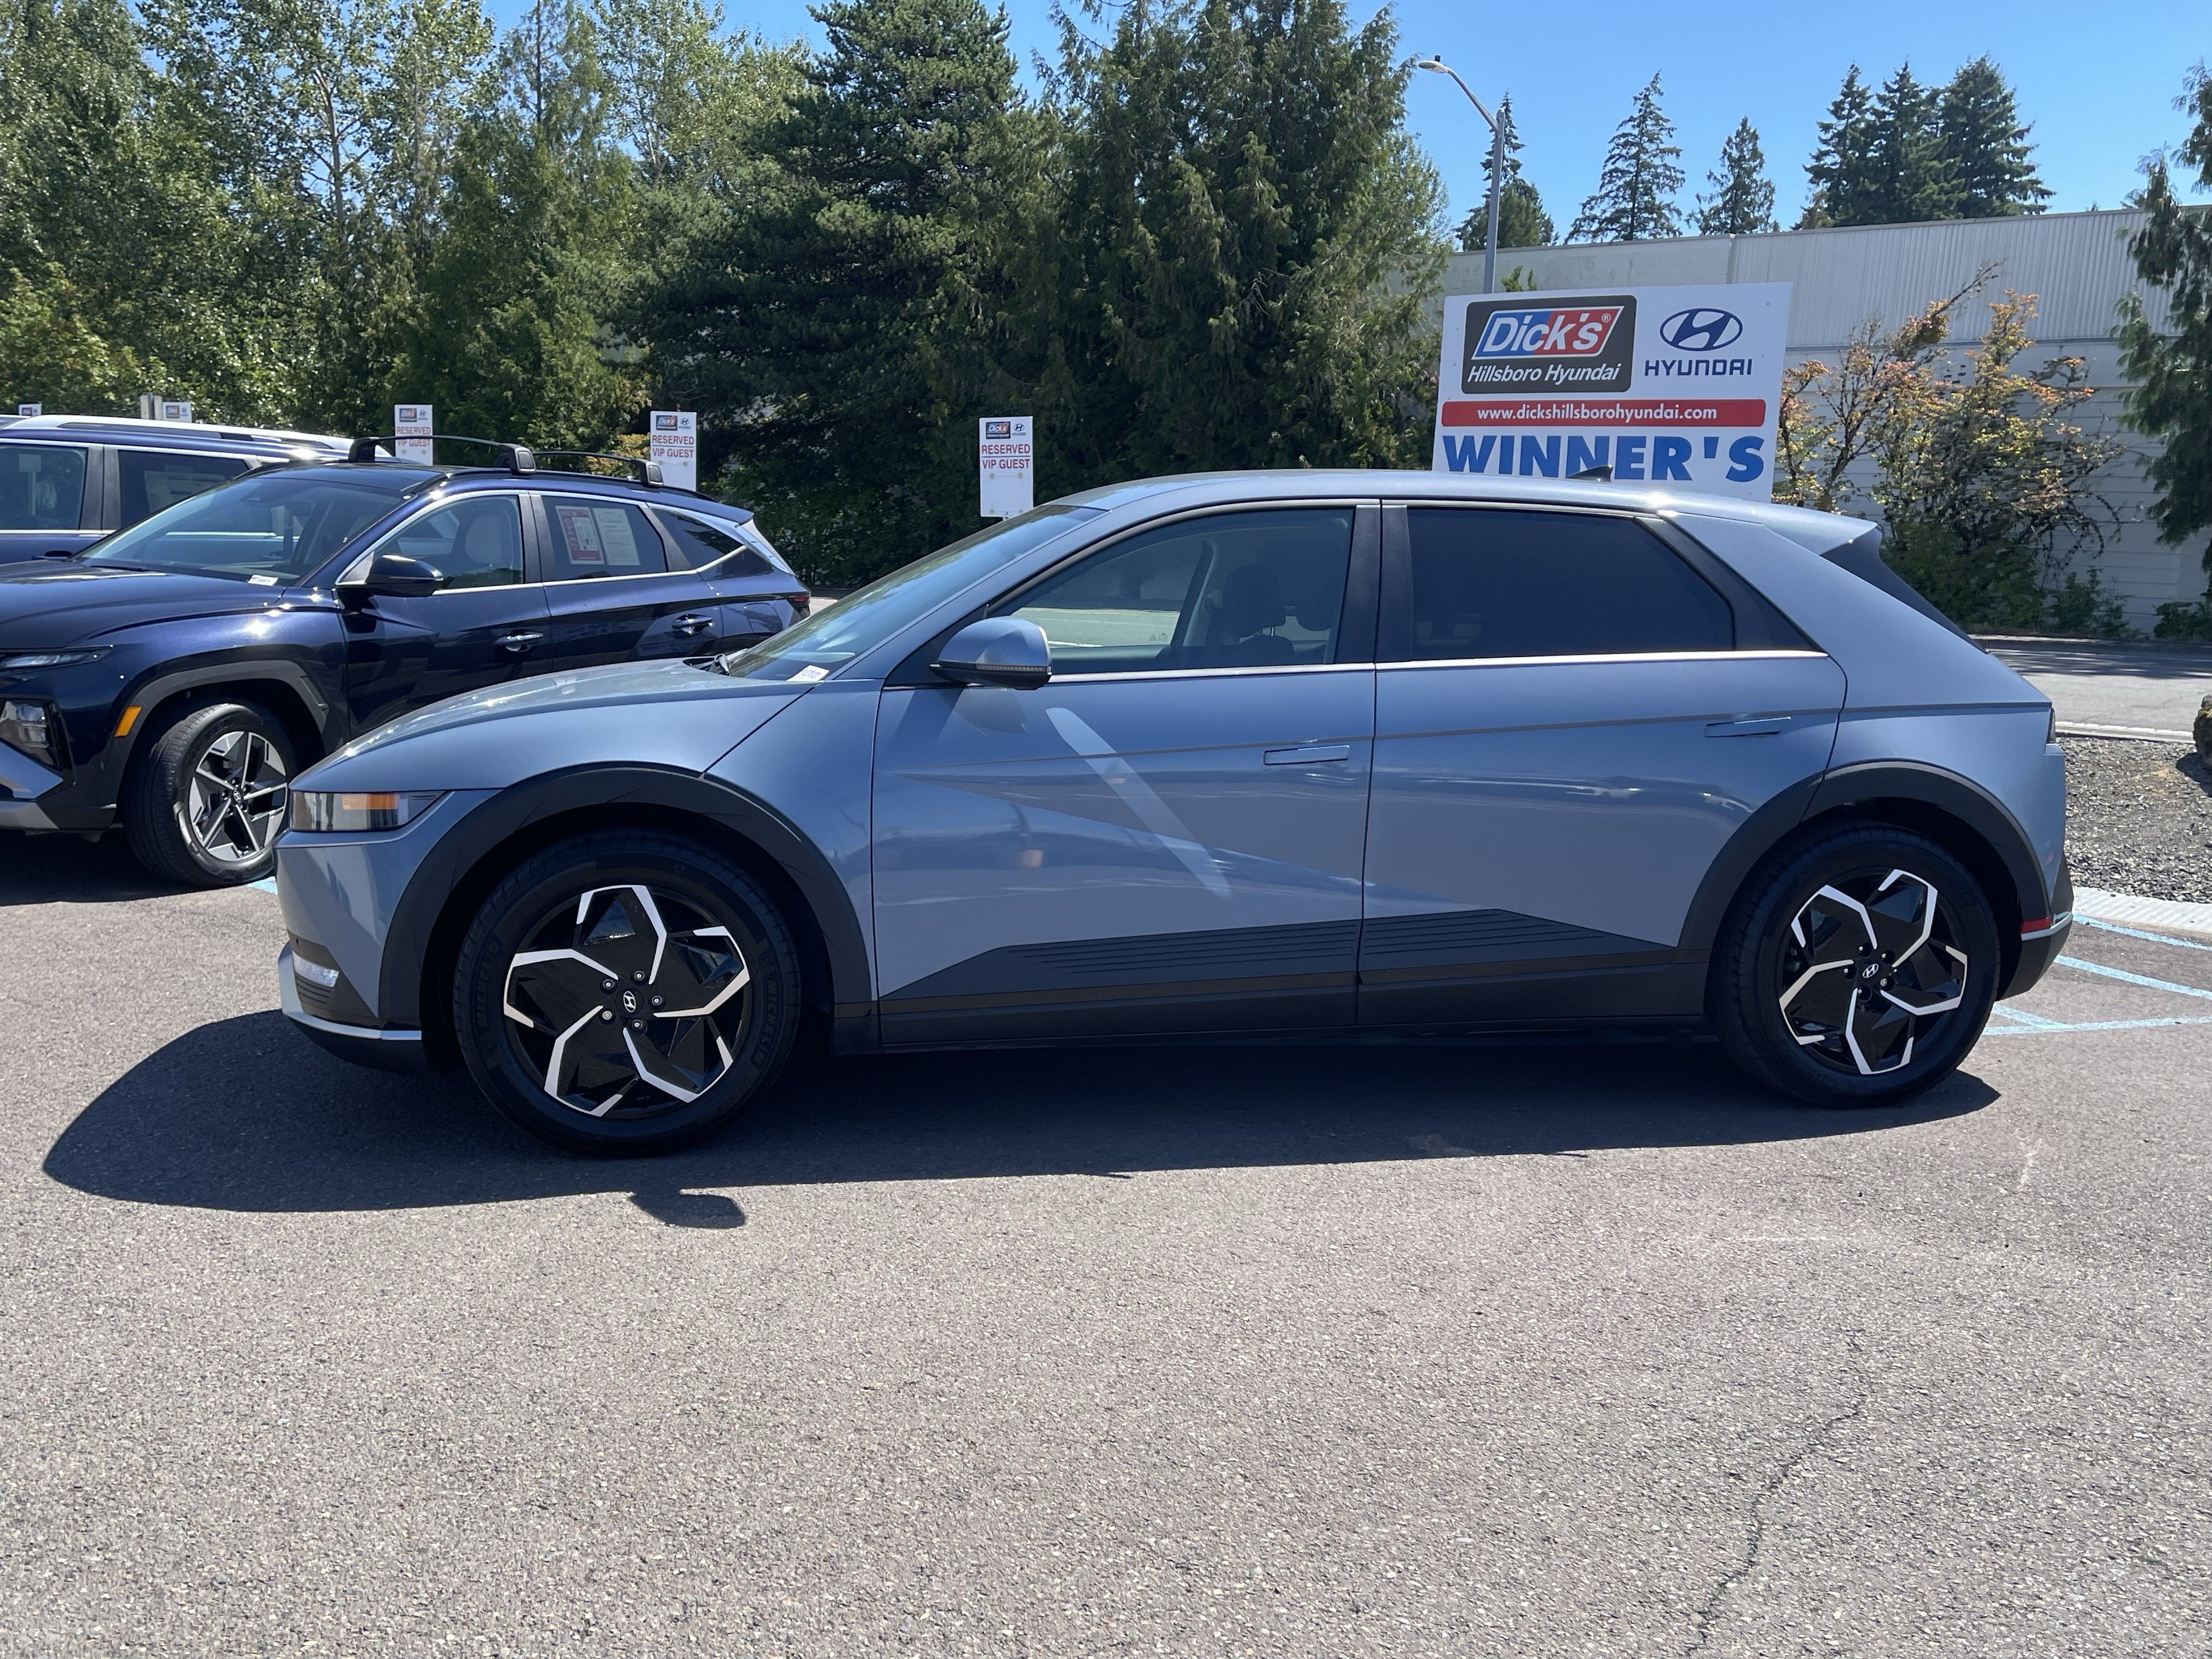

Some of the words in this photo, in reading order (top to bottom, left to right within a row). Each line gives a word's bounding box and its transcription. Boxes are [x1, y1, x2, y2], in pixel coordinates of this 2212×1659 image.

[1483, 313, 1602, 352] Dick's
[1467, 365, 1542, 382] Hillsboro
[1544, 363, 1622, 385] Hyundai
[1645, 359, 1752, 376] HYUNDAI
[1477, 403, 1717, 423] www.dickshillsborohyundai.com
[397, 426, 431, 435] RESERVED
[652, 435, 694, 444] RESERVED
[653, 448, 665, 456] VIP
[667, 449, 694, 458] GUEST
[981, 444, 1030, 454] RESERVED
[982, 459, 996, 469] VIP
[999, 459, 1030, 469] GUEST
[1442, 435, 1764, 482] WINNER'S
